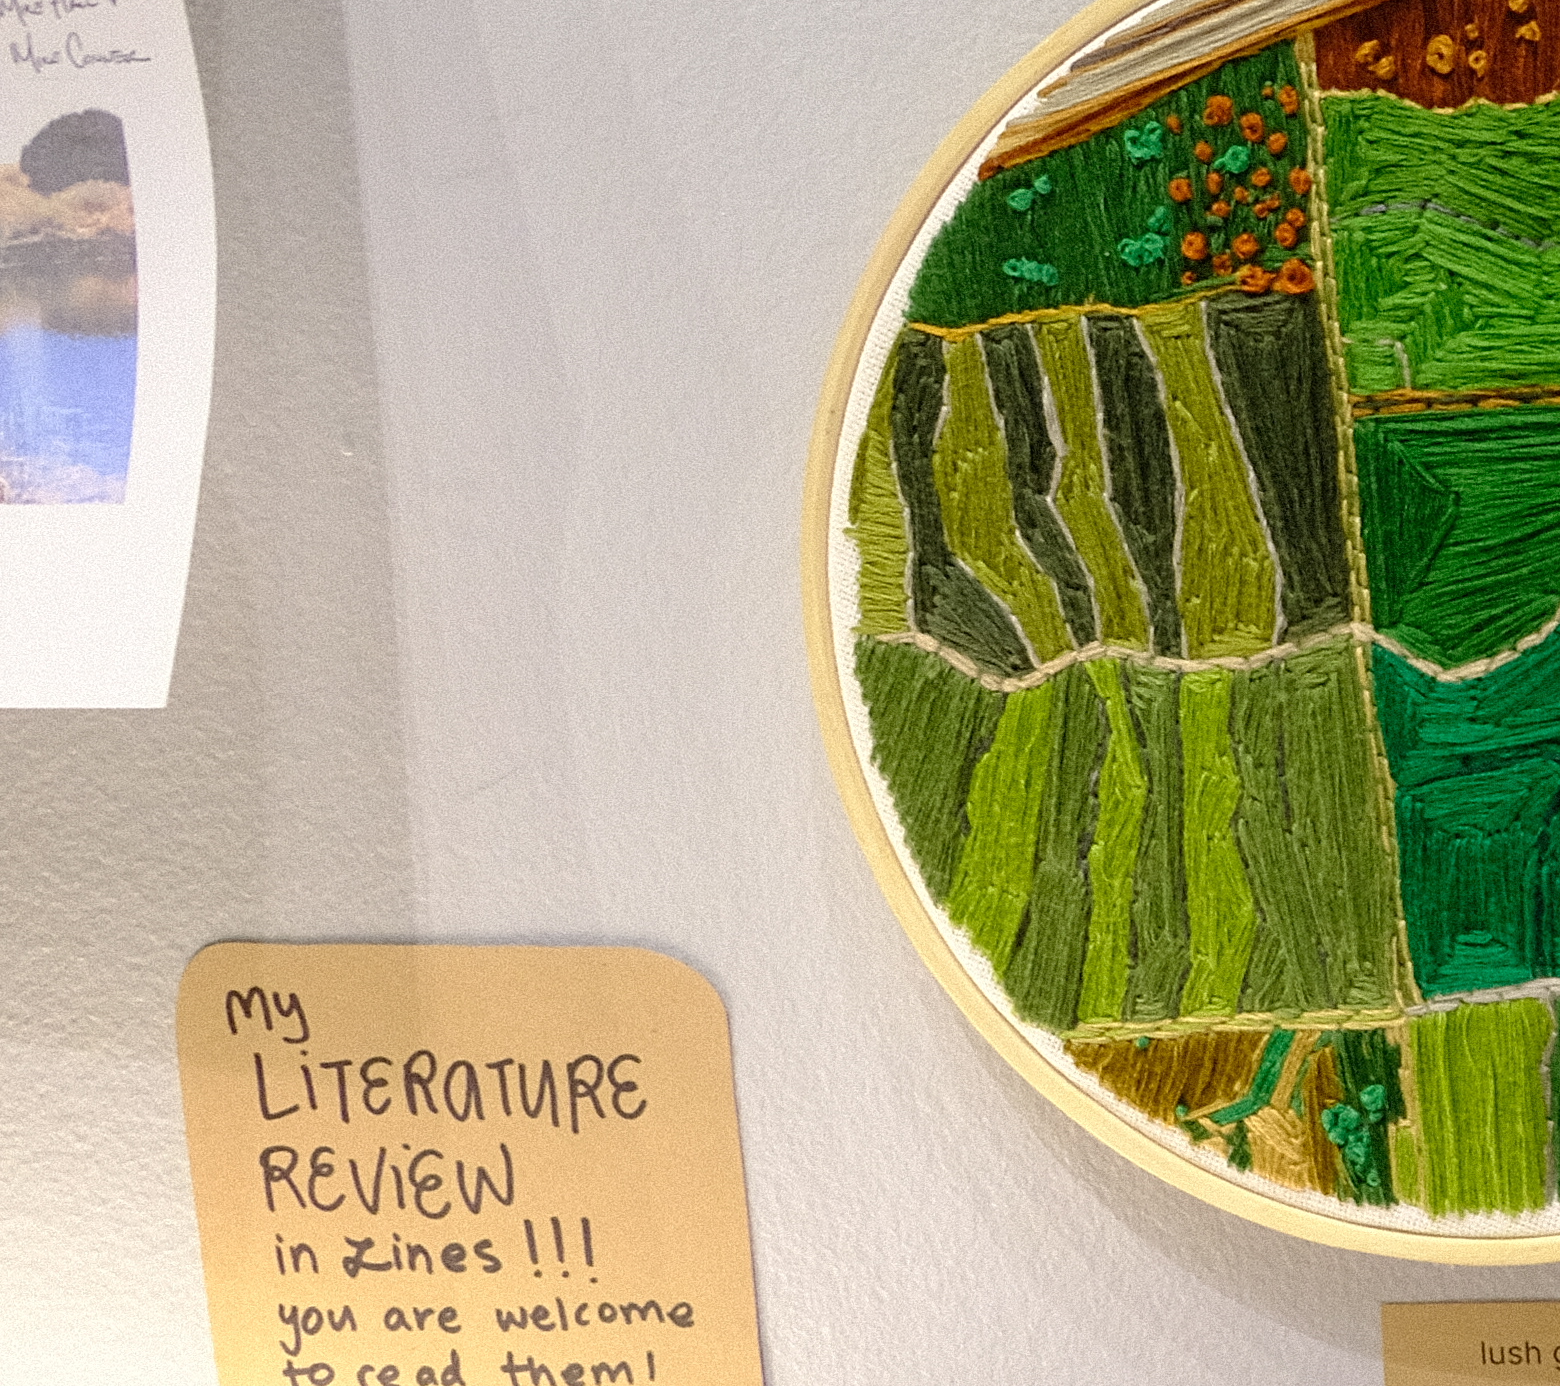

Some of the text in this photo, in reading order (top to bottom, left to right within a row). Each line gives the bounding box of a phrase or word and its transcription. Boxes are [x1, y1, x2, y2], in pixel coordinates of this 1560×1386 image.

[276, 1234, 318, 1274] in
[278, 1297, 695, 1356] you are welcome
[1481, 1341, 1541, 1365] lush
